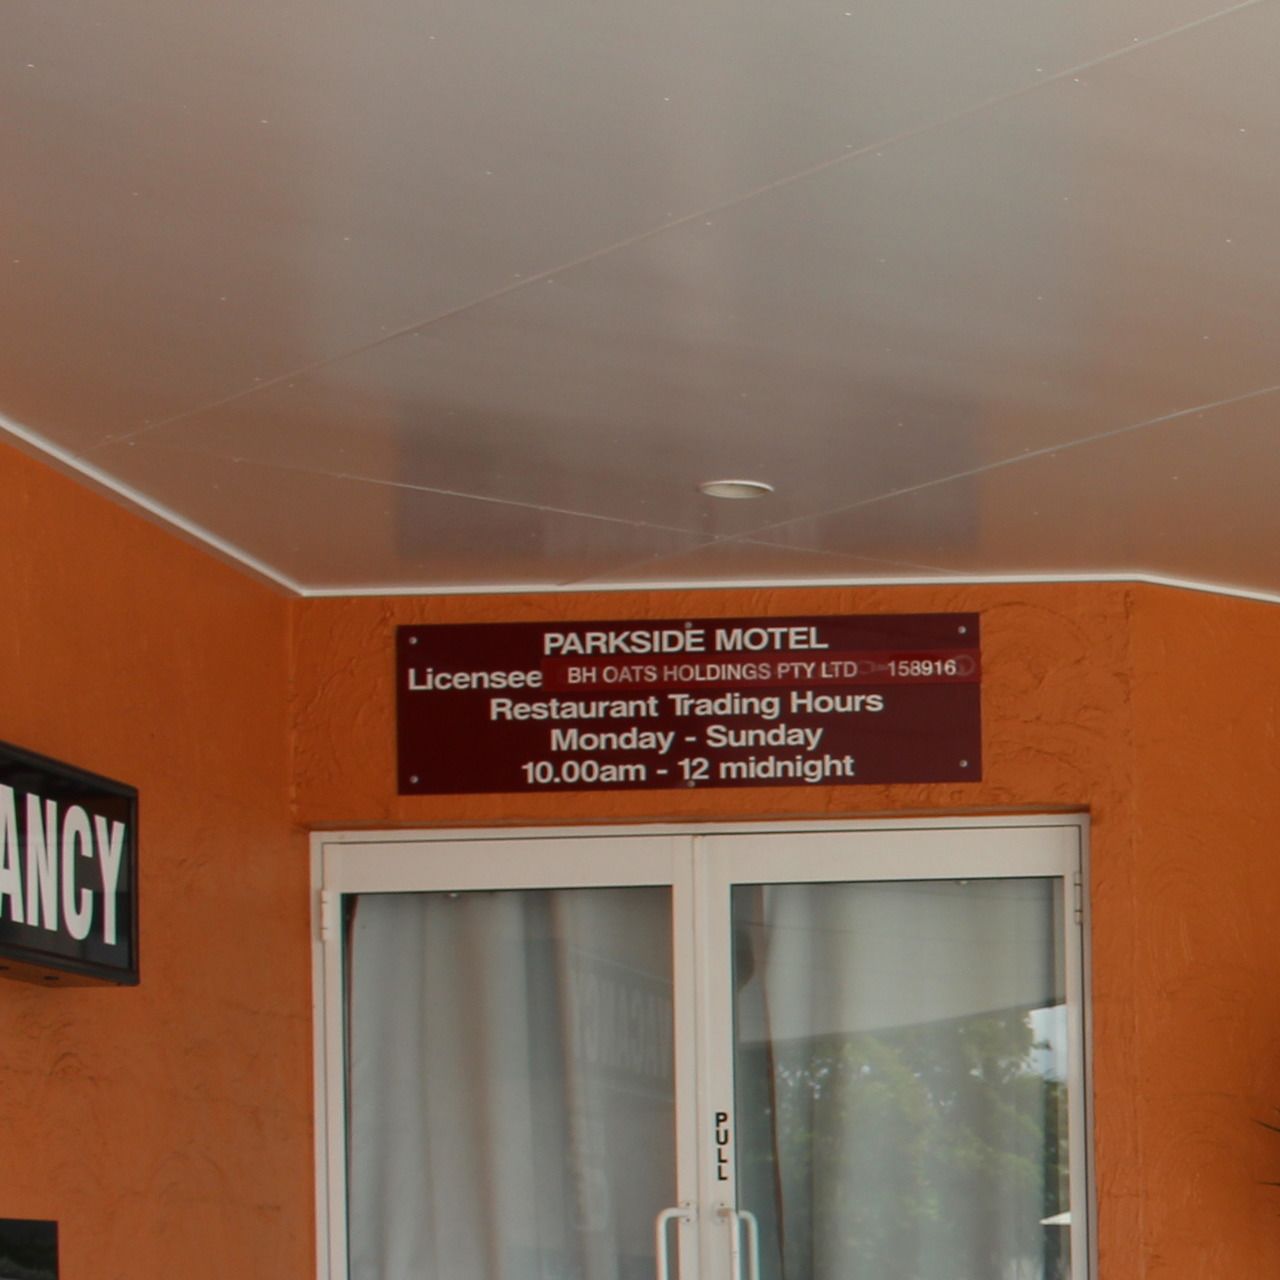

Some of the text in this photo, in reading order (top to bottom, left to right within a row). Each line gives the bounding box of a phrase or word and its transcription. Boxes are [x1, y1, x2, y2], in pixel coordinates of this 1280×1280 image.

[544, 626, 830, 656] PARKSIDE MOTEL
[408, 658, 957, 691] Licensee BH OATS HOLDINGS PTY LTD 158916
[490, 690, 885, 721] Restaurant Trading Hours
[550, 727, 675, 755] Monday
[706, 722, 824, 752] Sunday
[521, 759, 647, 784] 10.00am
[677, 757, 710, 780] 12
[719, 753, 855, 783] midnight
[0, 784, 126, 946] ANCY
[714, 1112, 730, 1182] PULL
